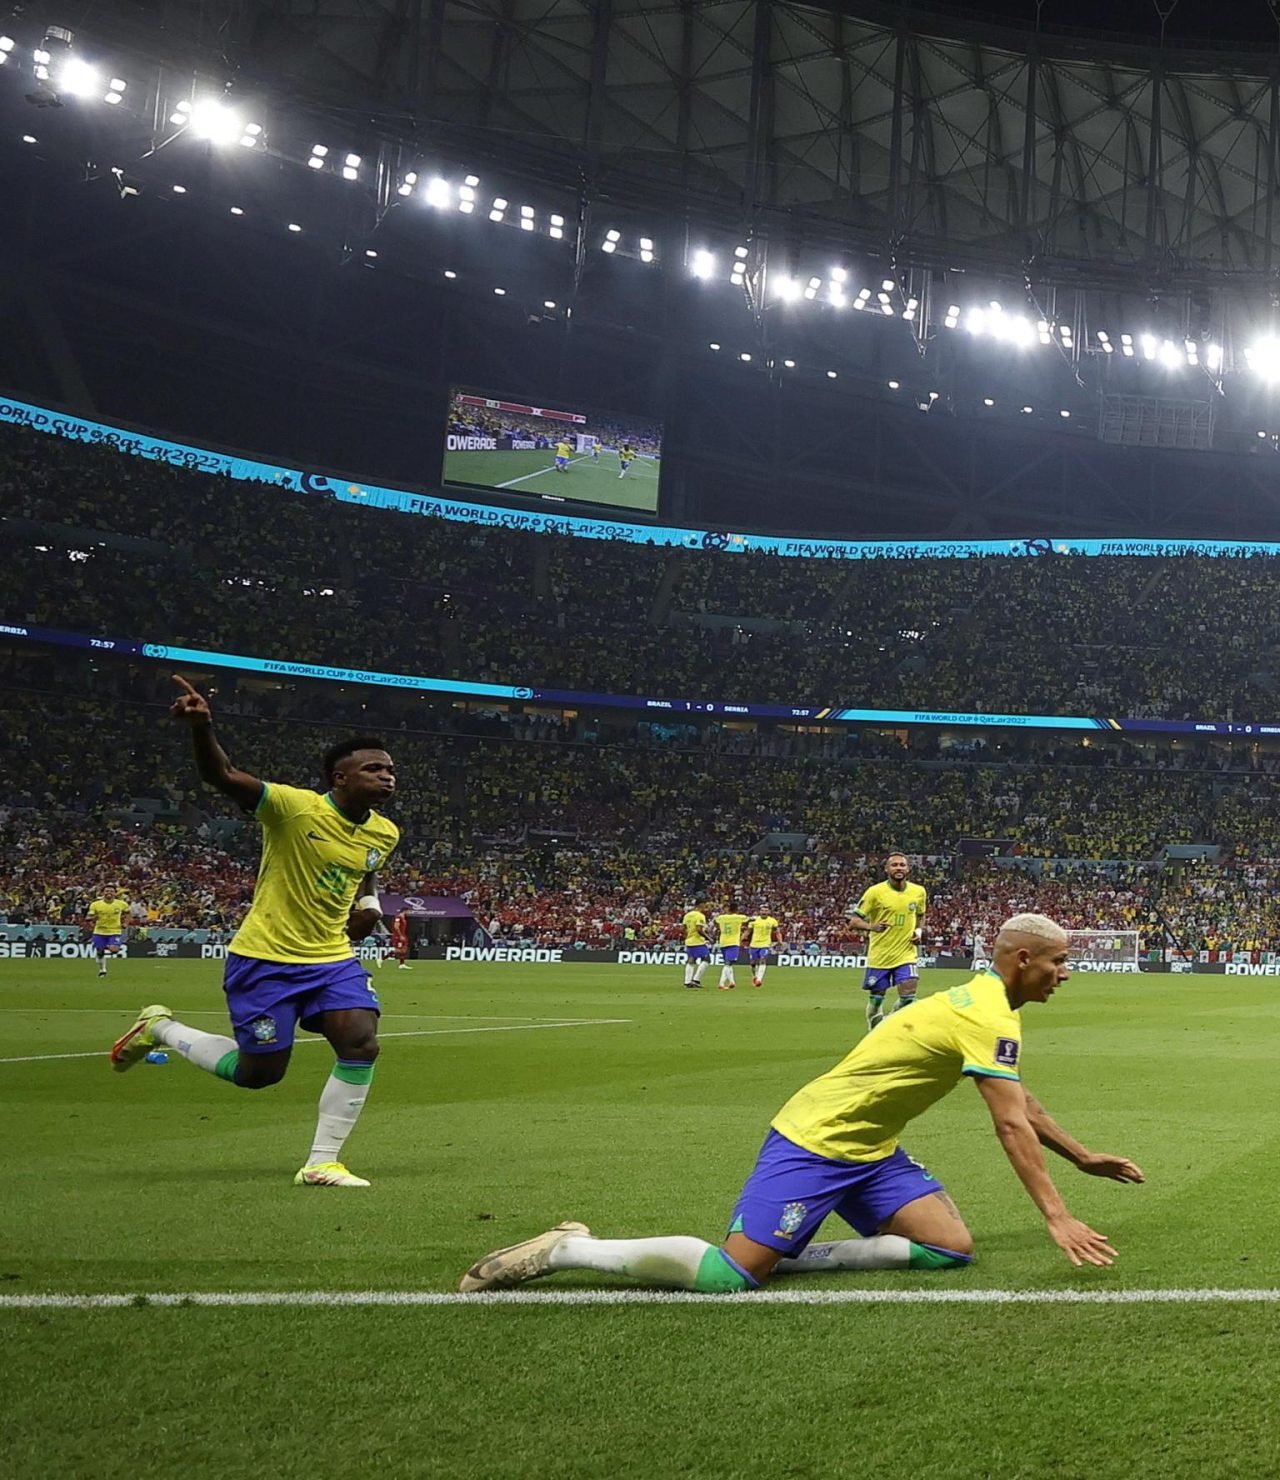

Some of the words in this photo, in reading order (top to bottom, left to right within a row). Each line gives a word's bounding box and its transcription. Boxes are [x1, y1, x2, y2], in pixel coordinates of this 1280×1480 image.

[0, 404, 48, 424] ORLD
[52, 419, 88, 435] CUP
[447, 434, 497, 450] OWERADE
[410, 499, 442, 513] FIFA
[445, 505, 499, 521] WORLD
[501, 514, 529, 526] CUP
[785, 543, 812, 553] FIFA
[813, 544, 858, 555] WORLD
[860, 545, 884, 556] CUP
[1101, 543, 1124, 552] FIFA
[1125, 543, 1164, 553] WORLD
[1166, 544, 1187, 553] CUP
[0, 625, 27, 636] ERBIA
[90, 639, 115, 649] 72:57
[263, 661, 287, 671] FIFA
[288, 664, 324, 677] WORLD
[326, 668, 346, 678] CUP
[914, 714, 930, 722] FIFA
[931, 714, 957, 722] WORLD
[958, 715, 973, 723] CUP
[446, 947, 563, 963] POWERADE
[778, 954, 867, 969] POWERAD
